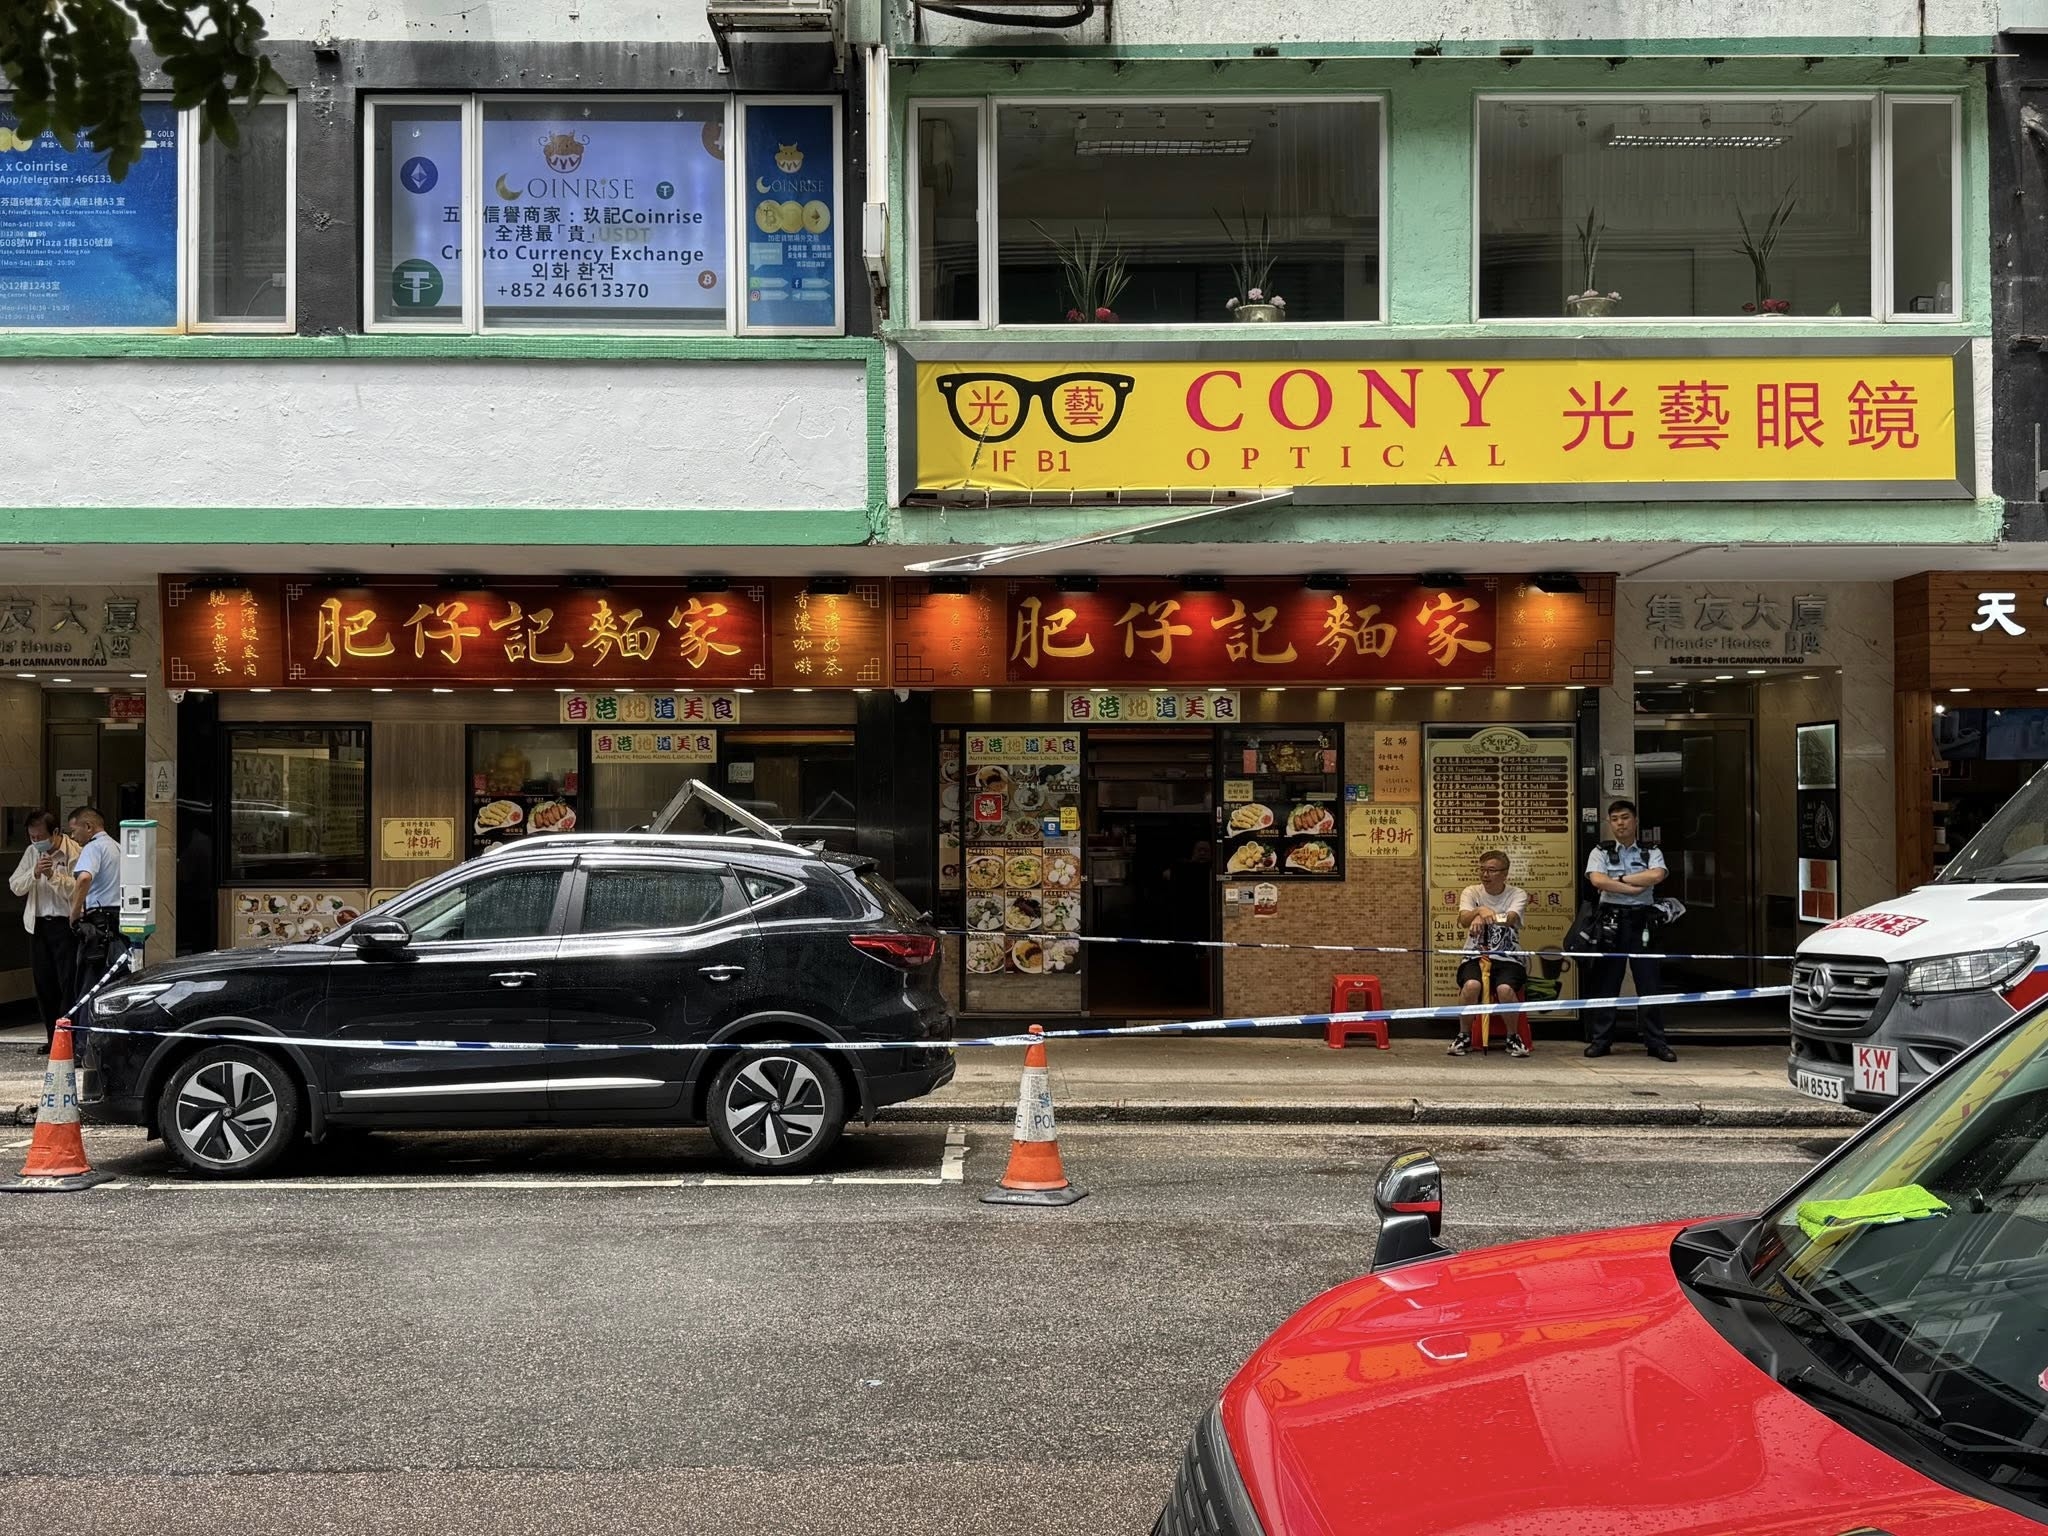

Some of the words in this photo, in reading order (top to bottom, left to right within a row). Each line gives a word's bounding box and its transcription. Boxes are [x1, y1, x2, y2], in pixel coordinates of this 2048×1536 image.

[157, 130, 175, 138] GOLD
[15, 160, 69, 172] Coinrise
[443, 205, 703, 224] 五信譽商家：玖記Coinrise
[36, 239, 61, 248] Plaza
[441, 246, 508, 262] Crto
[516, 245, 604, 264] Currency
[611, 245, 704, 266] Exchange
[531, 262, 570, 281] 외화
[578, 262, 614, 281] 환전
[498, 283, 546, 298] +852
[552, 283, 650, 298] 46613370
[968, 386, 1009, 426] 光
[1063, 386, 1105, 427] 藝
[1185, 368, 1505, 432] CONY
[1562, 379, 1920, 452] 光藝眼鏡
[1037, 450, 1071, 472] B1
[1186, 444, 1506, 471] OPTICAL
[1645, 594, 1829, 632] 集友大廈
[1971, 592, 2026, 637] 天
[313, 597, 742, 669] 肥仔記麵家
[1010, 592, 1493, 669] 肥仔記麵家
[21, 640, 73, 654] House
[1654, 636, 1719, 650] Friends'
[1722, 636, 1772, 650] House
[22, 658, 80, 668] CARNARVON
[81, 658, 108, 668] ROAD
[1730, 656, 1781, 665] CARNARVON
[1782, 656, 1805, 665] ROAD
[566, 695, 734, 721] 香港地道美食
[1069, 694, 1235, 720] 香港地道美食
[597, 735, 714, 751] 香港地道美食
[969, 738, 1077, 753] 香港地道美食
[156, 765, 169, 794] A座
[1612, 763, 1625, 791] B座
[393, 836, 442, 849] 一律9折
[1352, 826, 1414, 845] 一律9折
[1434, 920, 1454, 931] Daily
[1859, 1047, 1891, 1070] KW
[1799, 1073, 1809, 1091] AM
[1810, 1075, 1840, 1099] 8533
[1863, 1068, 1886, 1092] 1/1
